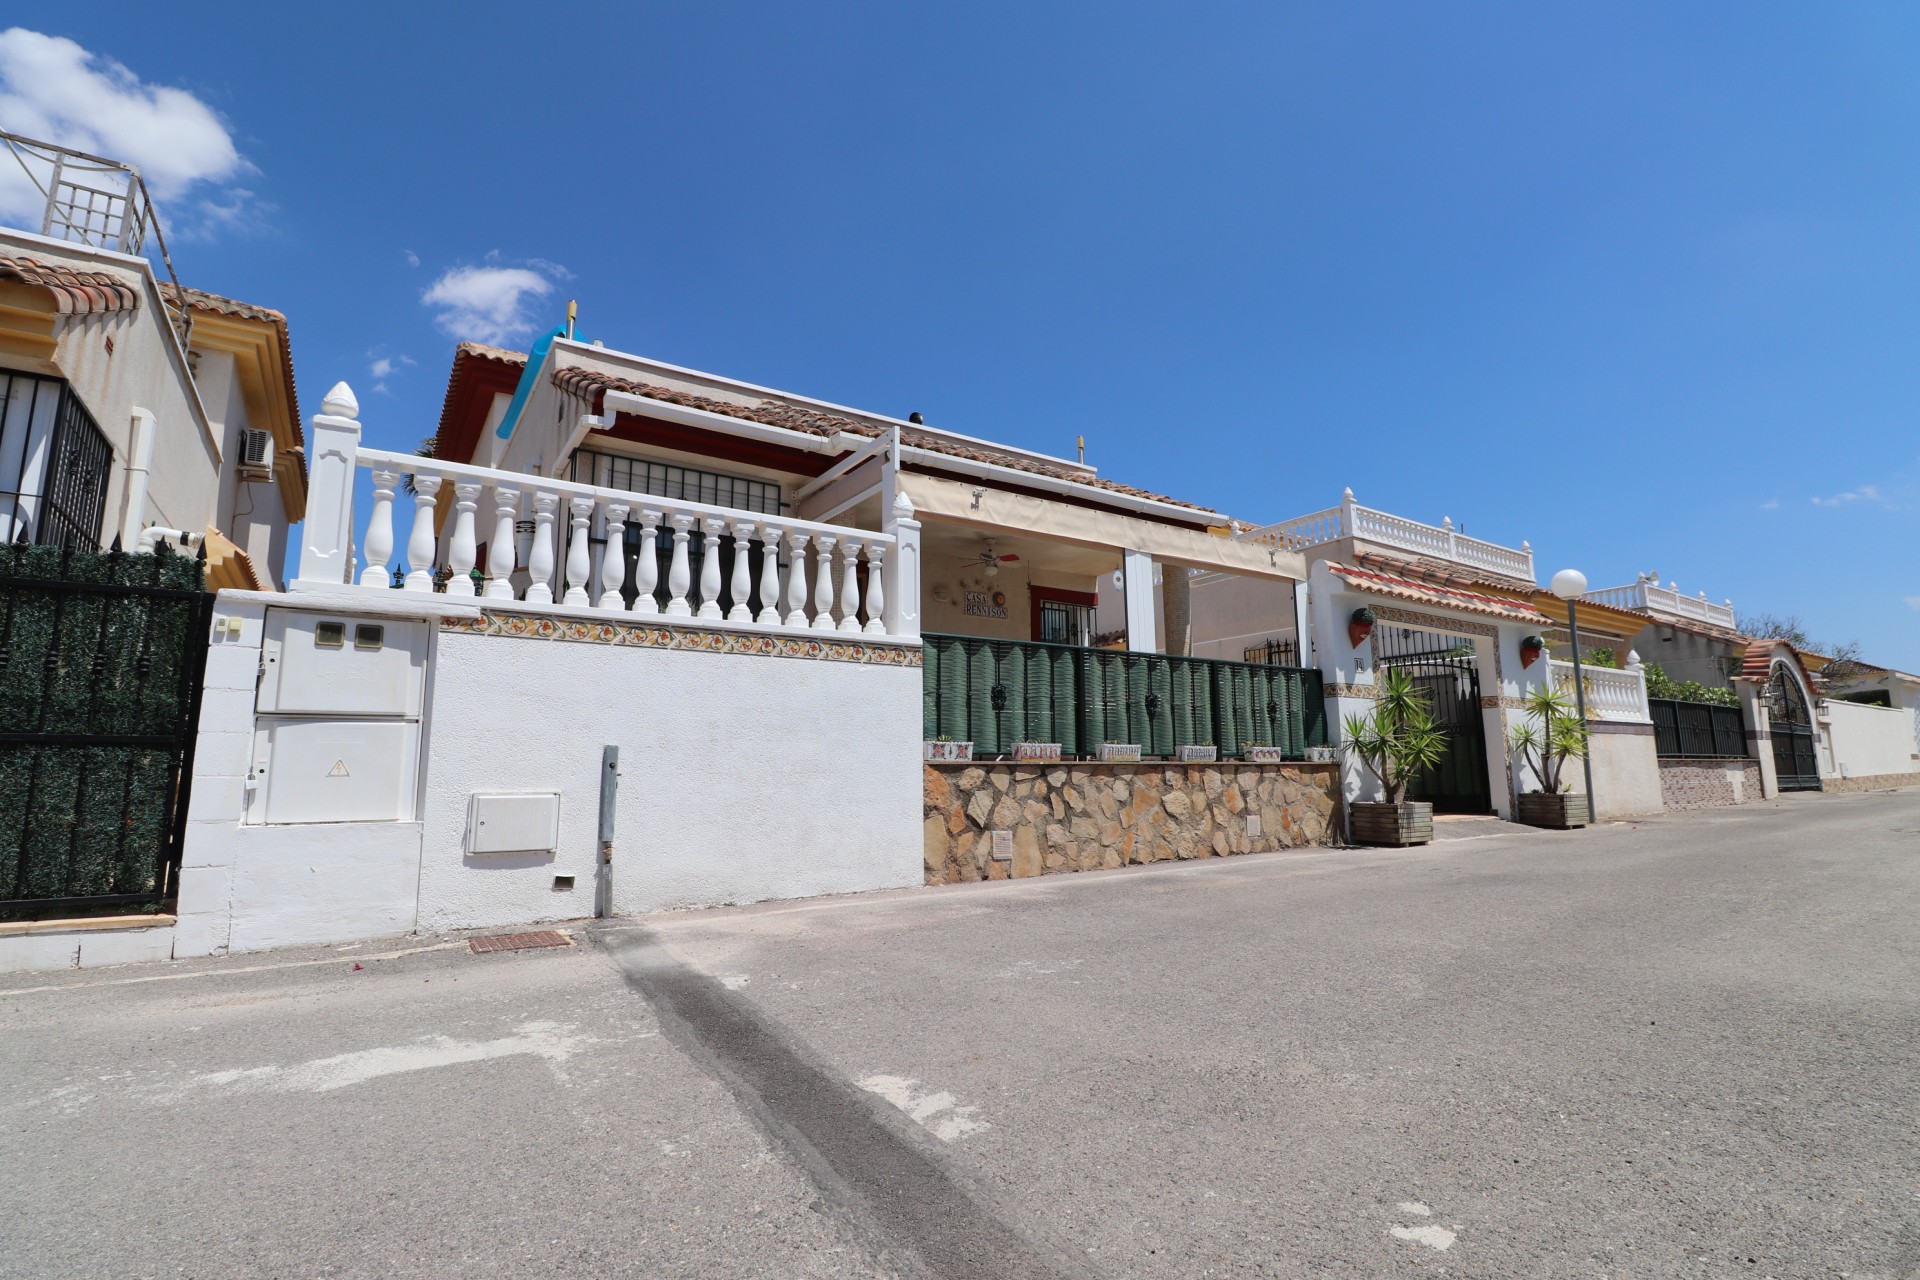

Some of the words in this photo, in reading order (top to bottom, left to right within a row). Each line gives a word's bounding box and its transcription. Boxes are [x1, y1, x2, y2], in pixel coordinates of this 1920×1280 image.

[966, 593, 986, 602] CASA
[966, 604, 1006, 617] RENNISON
[1355, 659, 1363, 671] 14
